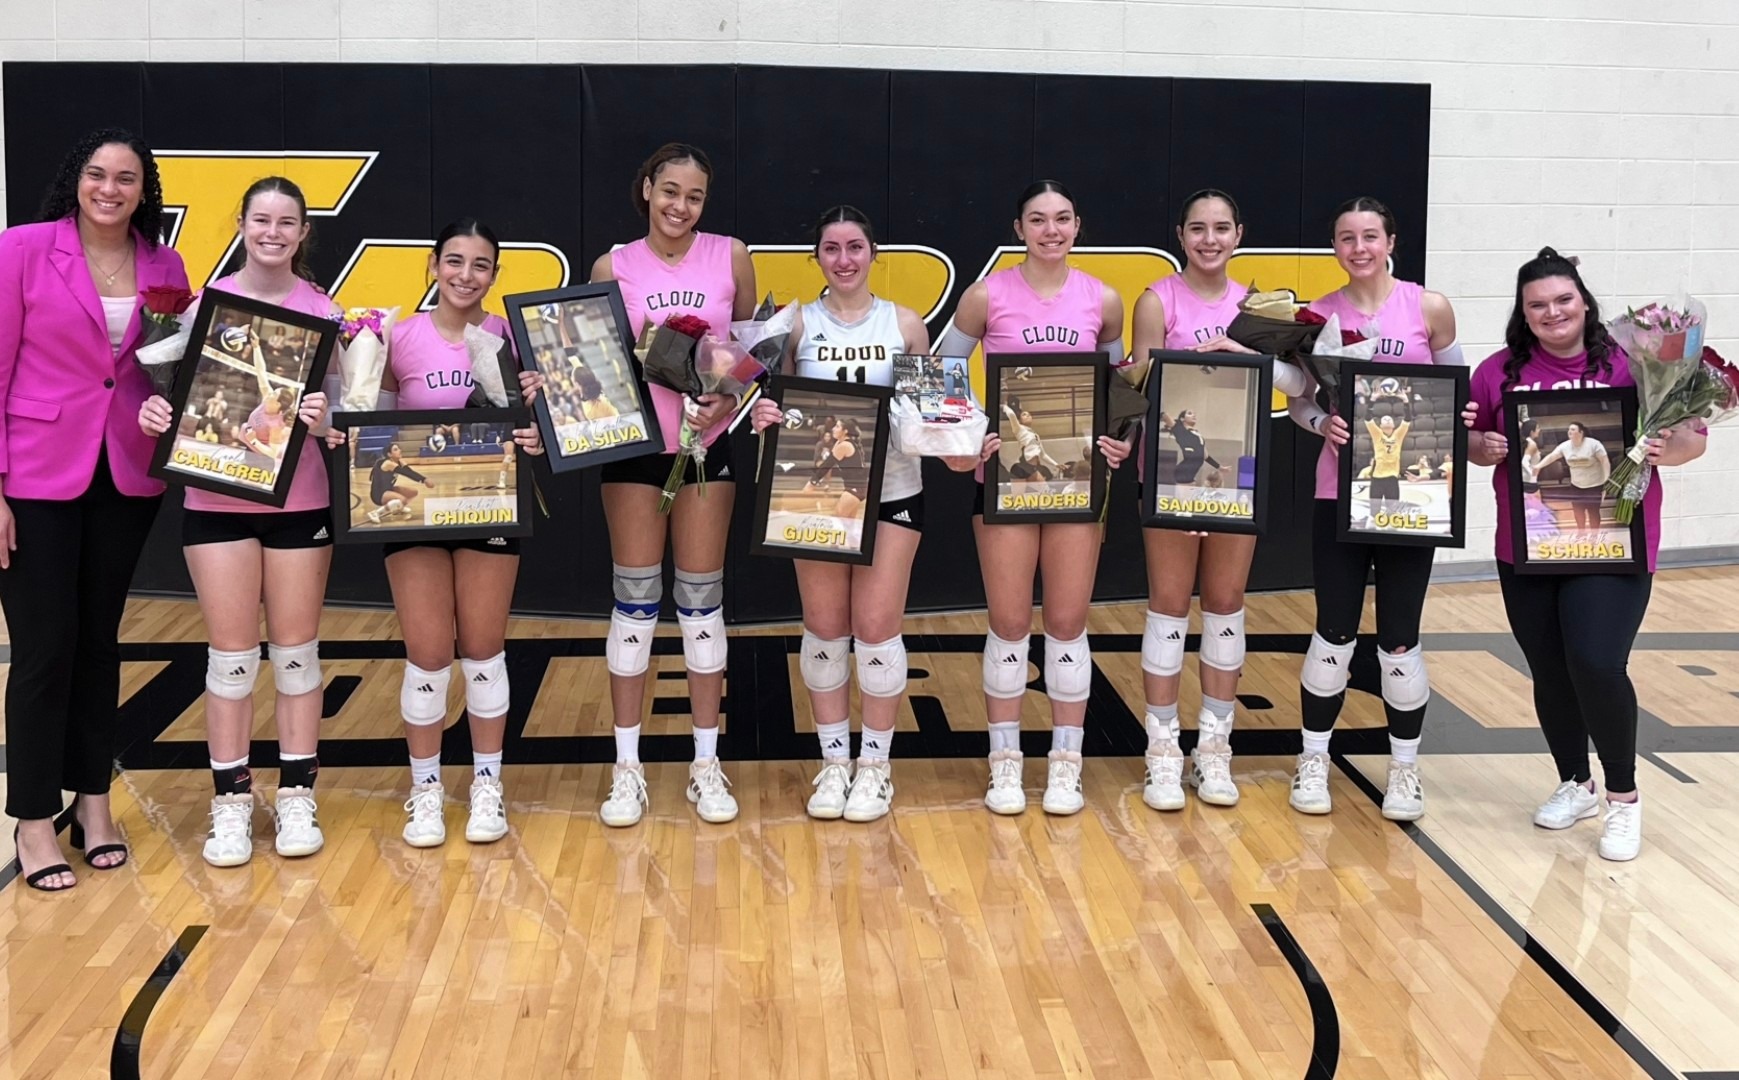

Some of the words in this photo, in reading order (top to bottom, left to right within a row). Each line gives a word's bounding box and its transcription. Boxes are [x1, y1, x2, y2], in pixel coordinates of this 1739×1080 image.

[645, 291, 706, 311] CLOUD
[1022, 325, 1080, 347] CLOUD
[817, 344, 886, 362] CLOUD
[425, 366, 476, 389] CLOU
[564, 435, 590, 453] DA
[594, 424, 644, 447] SILVA
[173, 448, 275, 487] CARLGREN
[1001, 492, 1089, 510] SANDERS
[1157, 497, 1253, 516] SANDOVAL
[431, 508, 514, 526] CHIQUIN
[1374, 511, 1428, 530] OGLE
[783, 523, 847, 546] GIUSTI
[1536, 541, 1625, 559] SCHRAG
